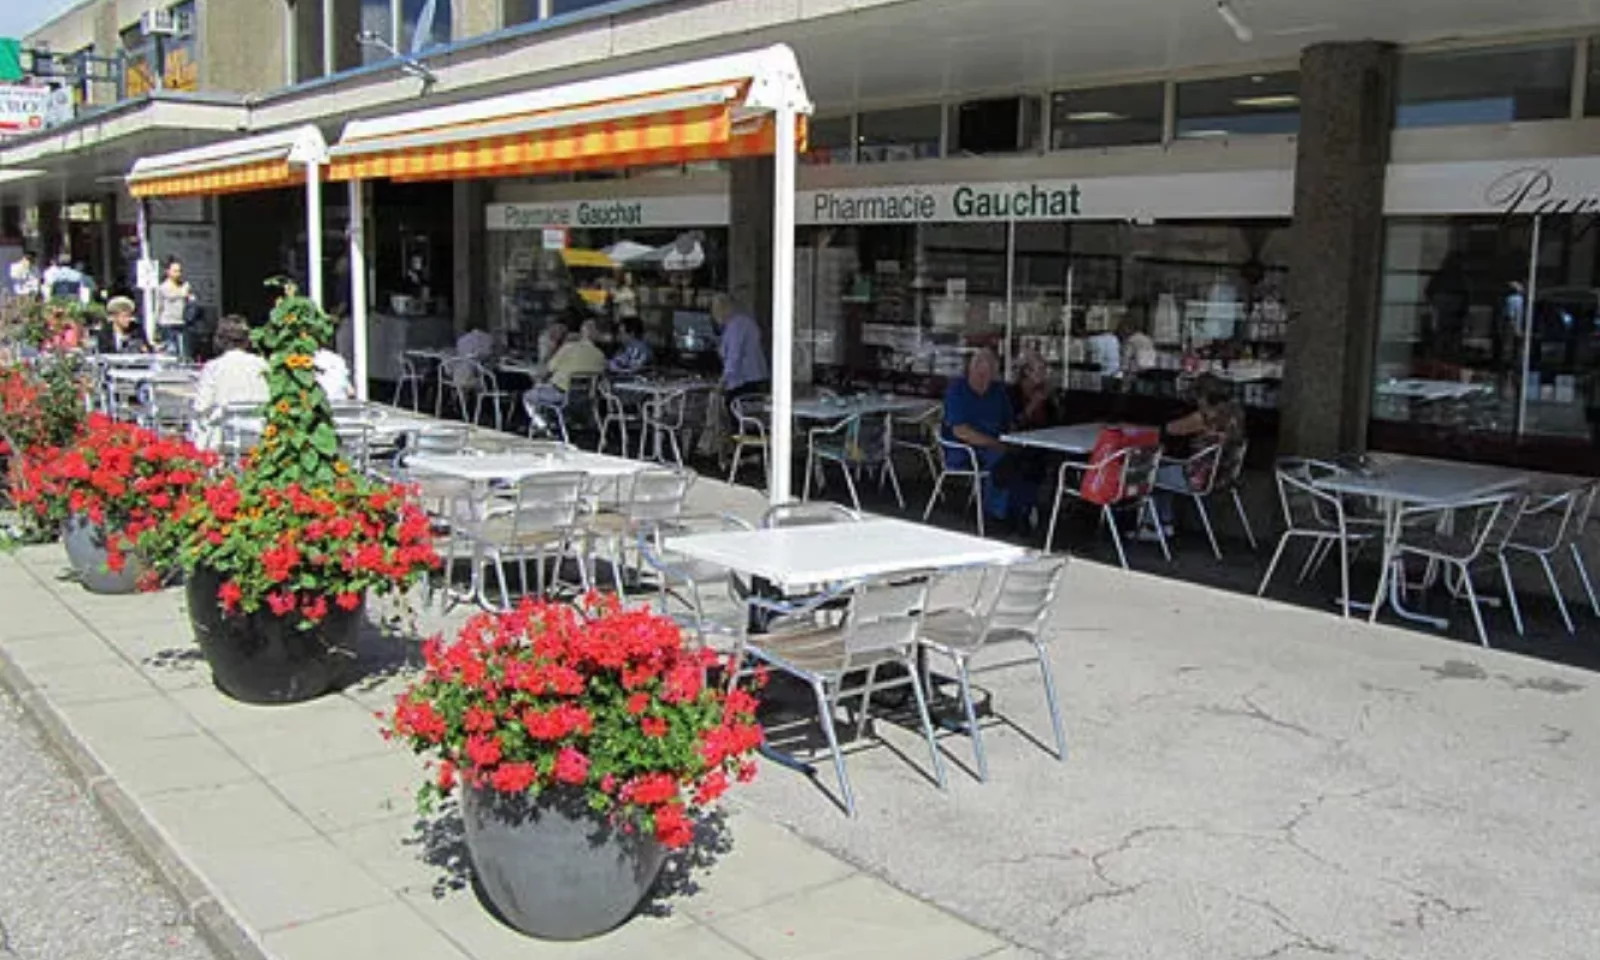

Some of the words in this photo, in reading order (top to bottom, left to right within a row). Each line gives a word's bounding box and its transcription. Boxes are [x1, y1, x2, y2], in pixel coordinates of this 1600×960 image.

[577, 202, 642, 225] Gauchat
[814, 190, 936, 219] Pharmacie
[953, 184, 1081, 217] Gauchat
